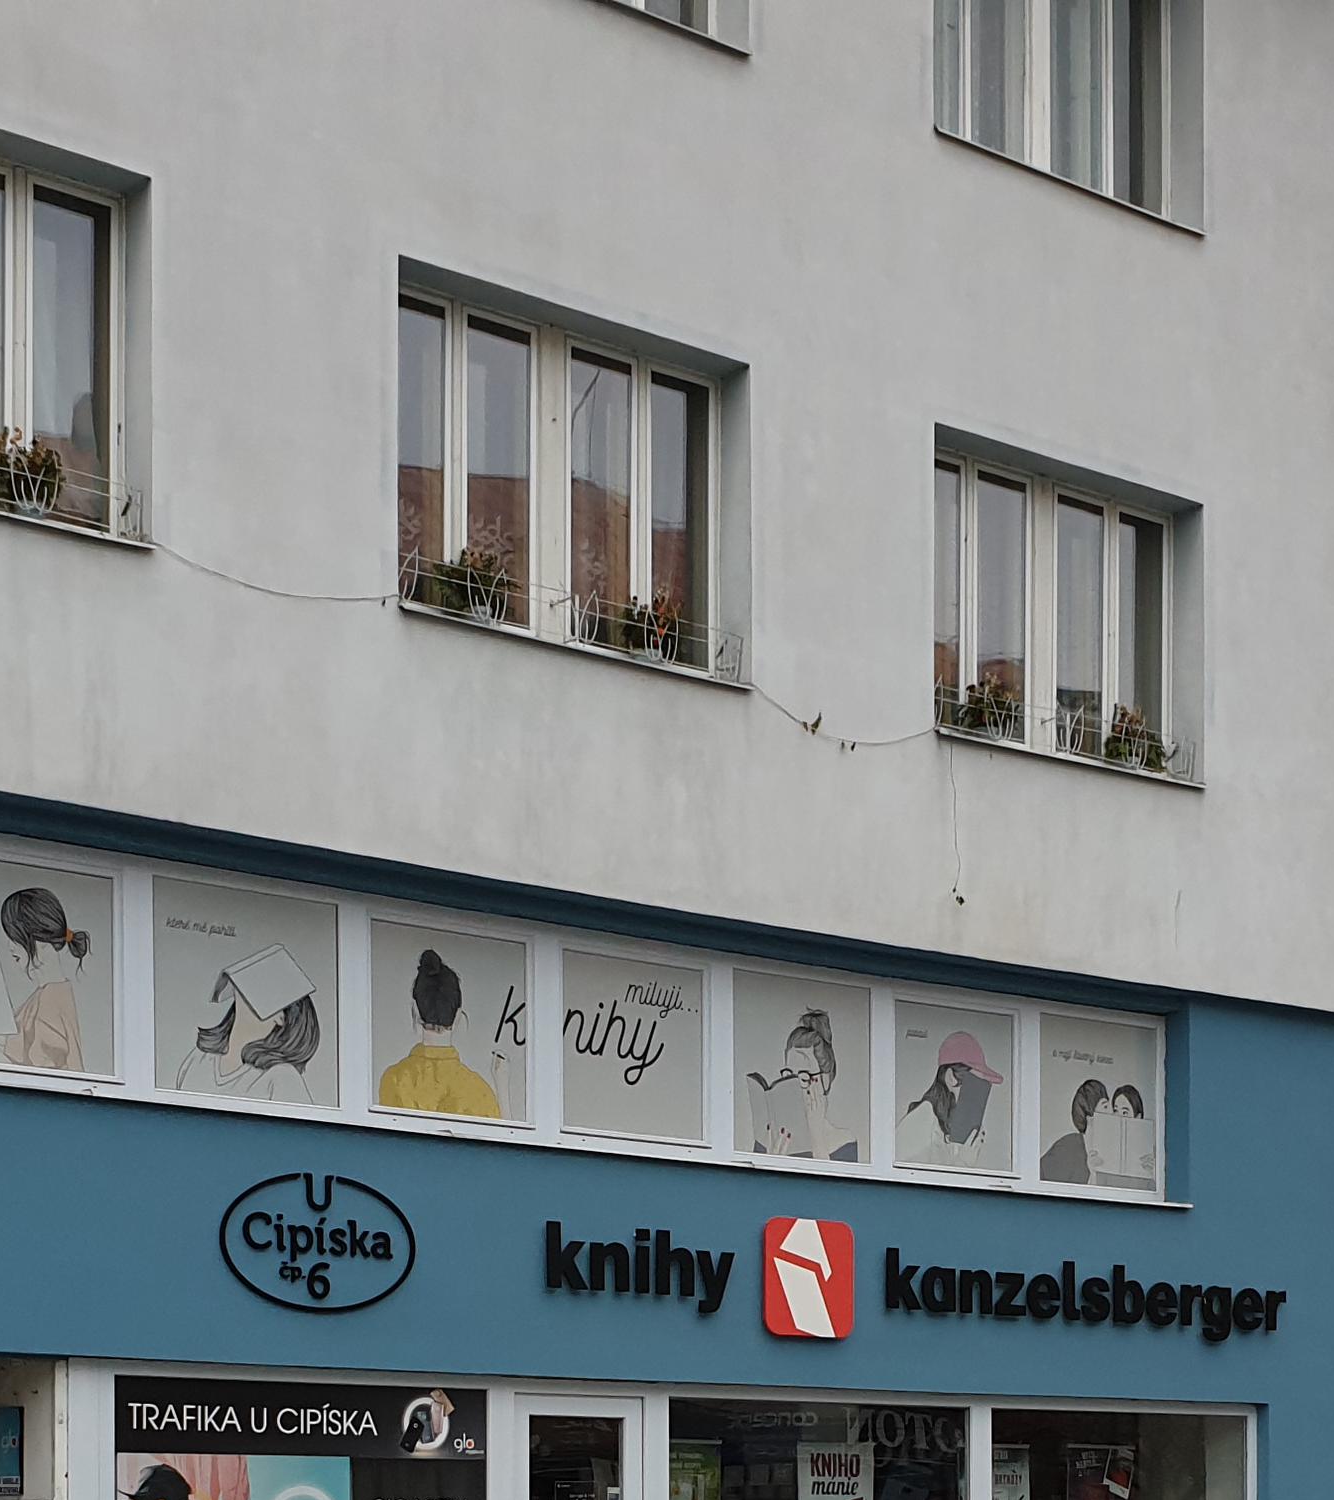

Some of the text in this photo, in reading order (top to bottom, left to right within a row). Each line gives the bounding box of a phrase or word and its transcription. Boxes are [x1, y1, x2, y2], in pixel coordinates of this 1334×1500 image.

[303, 1172, 335, 1212] U
[242, 1211, 394, 1262] Cipíska
[307, 1262, 331, 1300] 6
[546, 1221, 1287, 1342] knihy kanzelsberger
[127, 1402, 378, 1437] TRAFIKA U CIPÍSKA
[454, 1432, 475, 1453] glo
[810, 1453, 860, 1478] KNIHO
